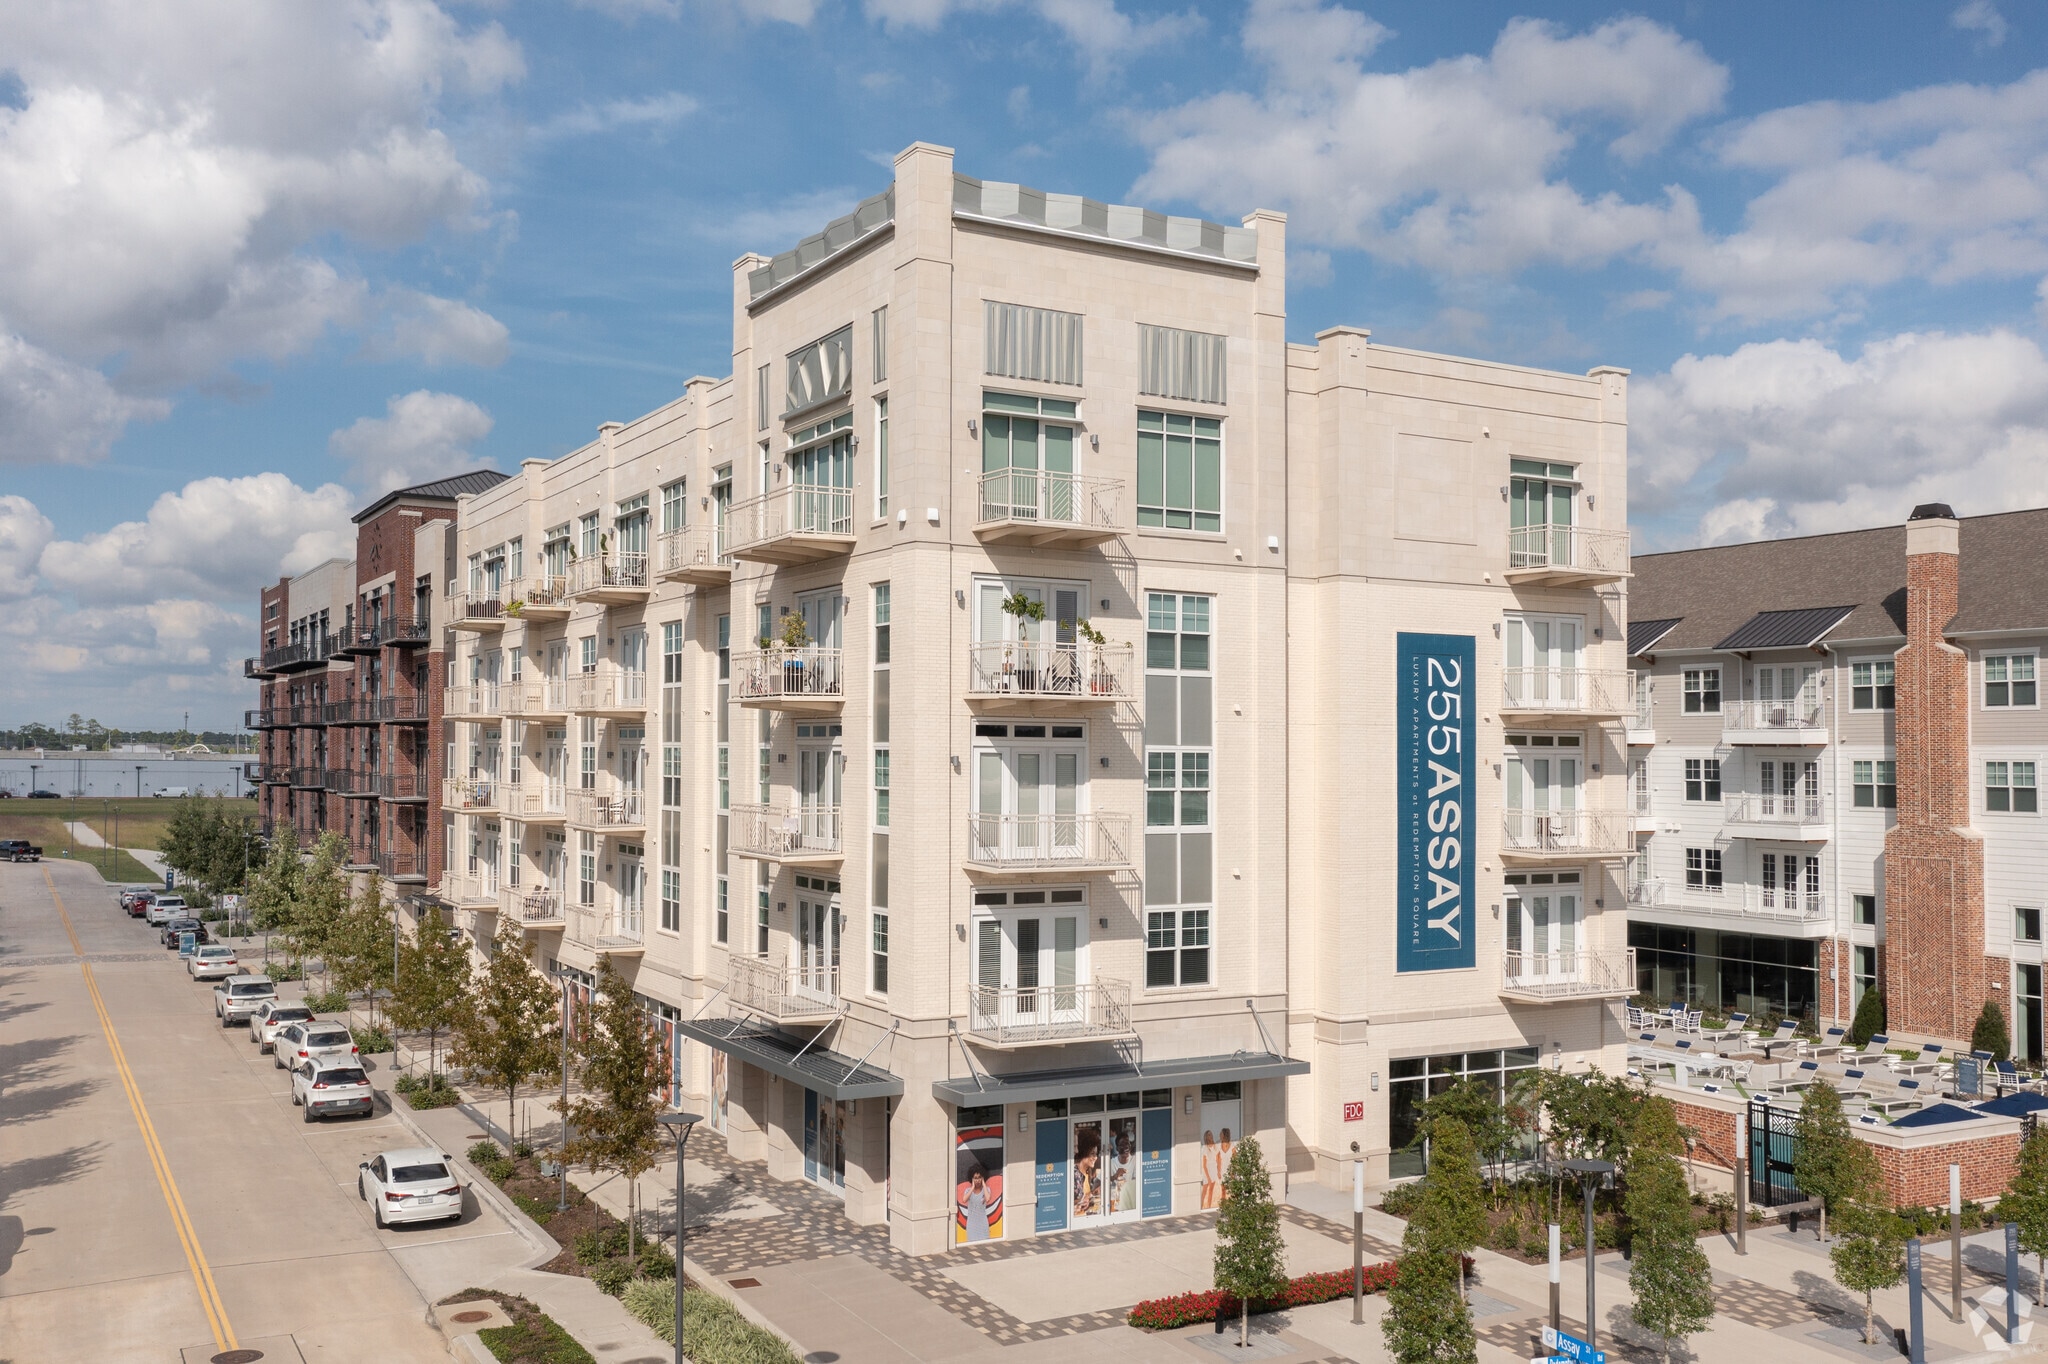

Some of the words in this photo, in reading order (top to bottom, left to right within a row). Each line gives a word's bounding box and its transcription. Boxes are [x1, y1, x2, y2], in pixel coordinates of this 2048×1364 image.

[1412, 794, 1418, 805] at
[1345, 1104, 1362, 1117] FDC
[1558, 1334, 1580, 1359] Assay
[1585, 1345, 1591, 1354] St
[1597, 1354, 1603, 1362] Rd
